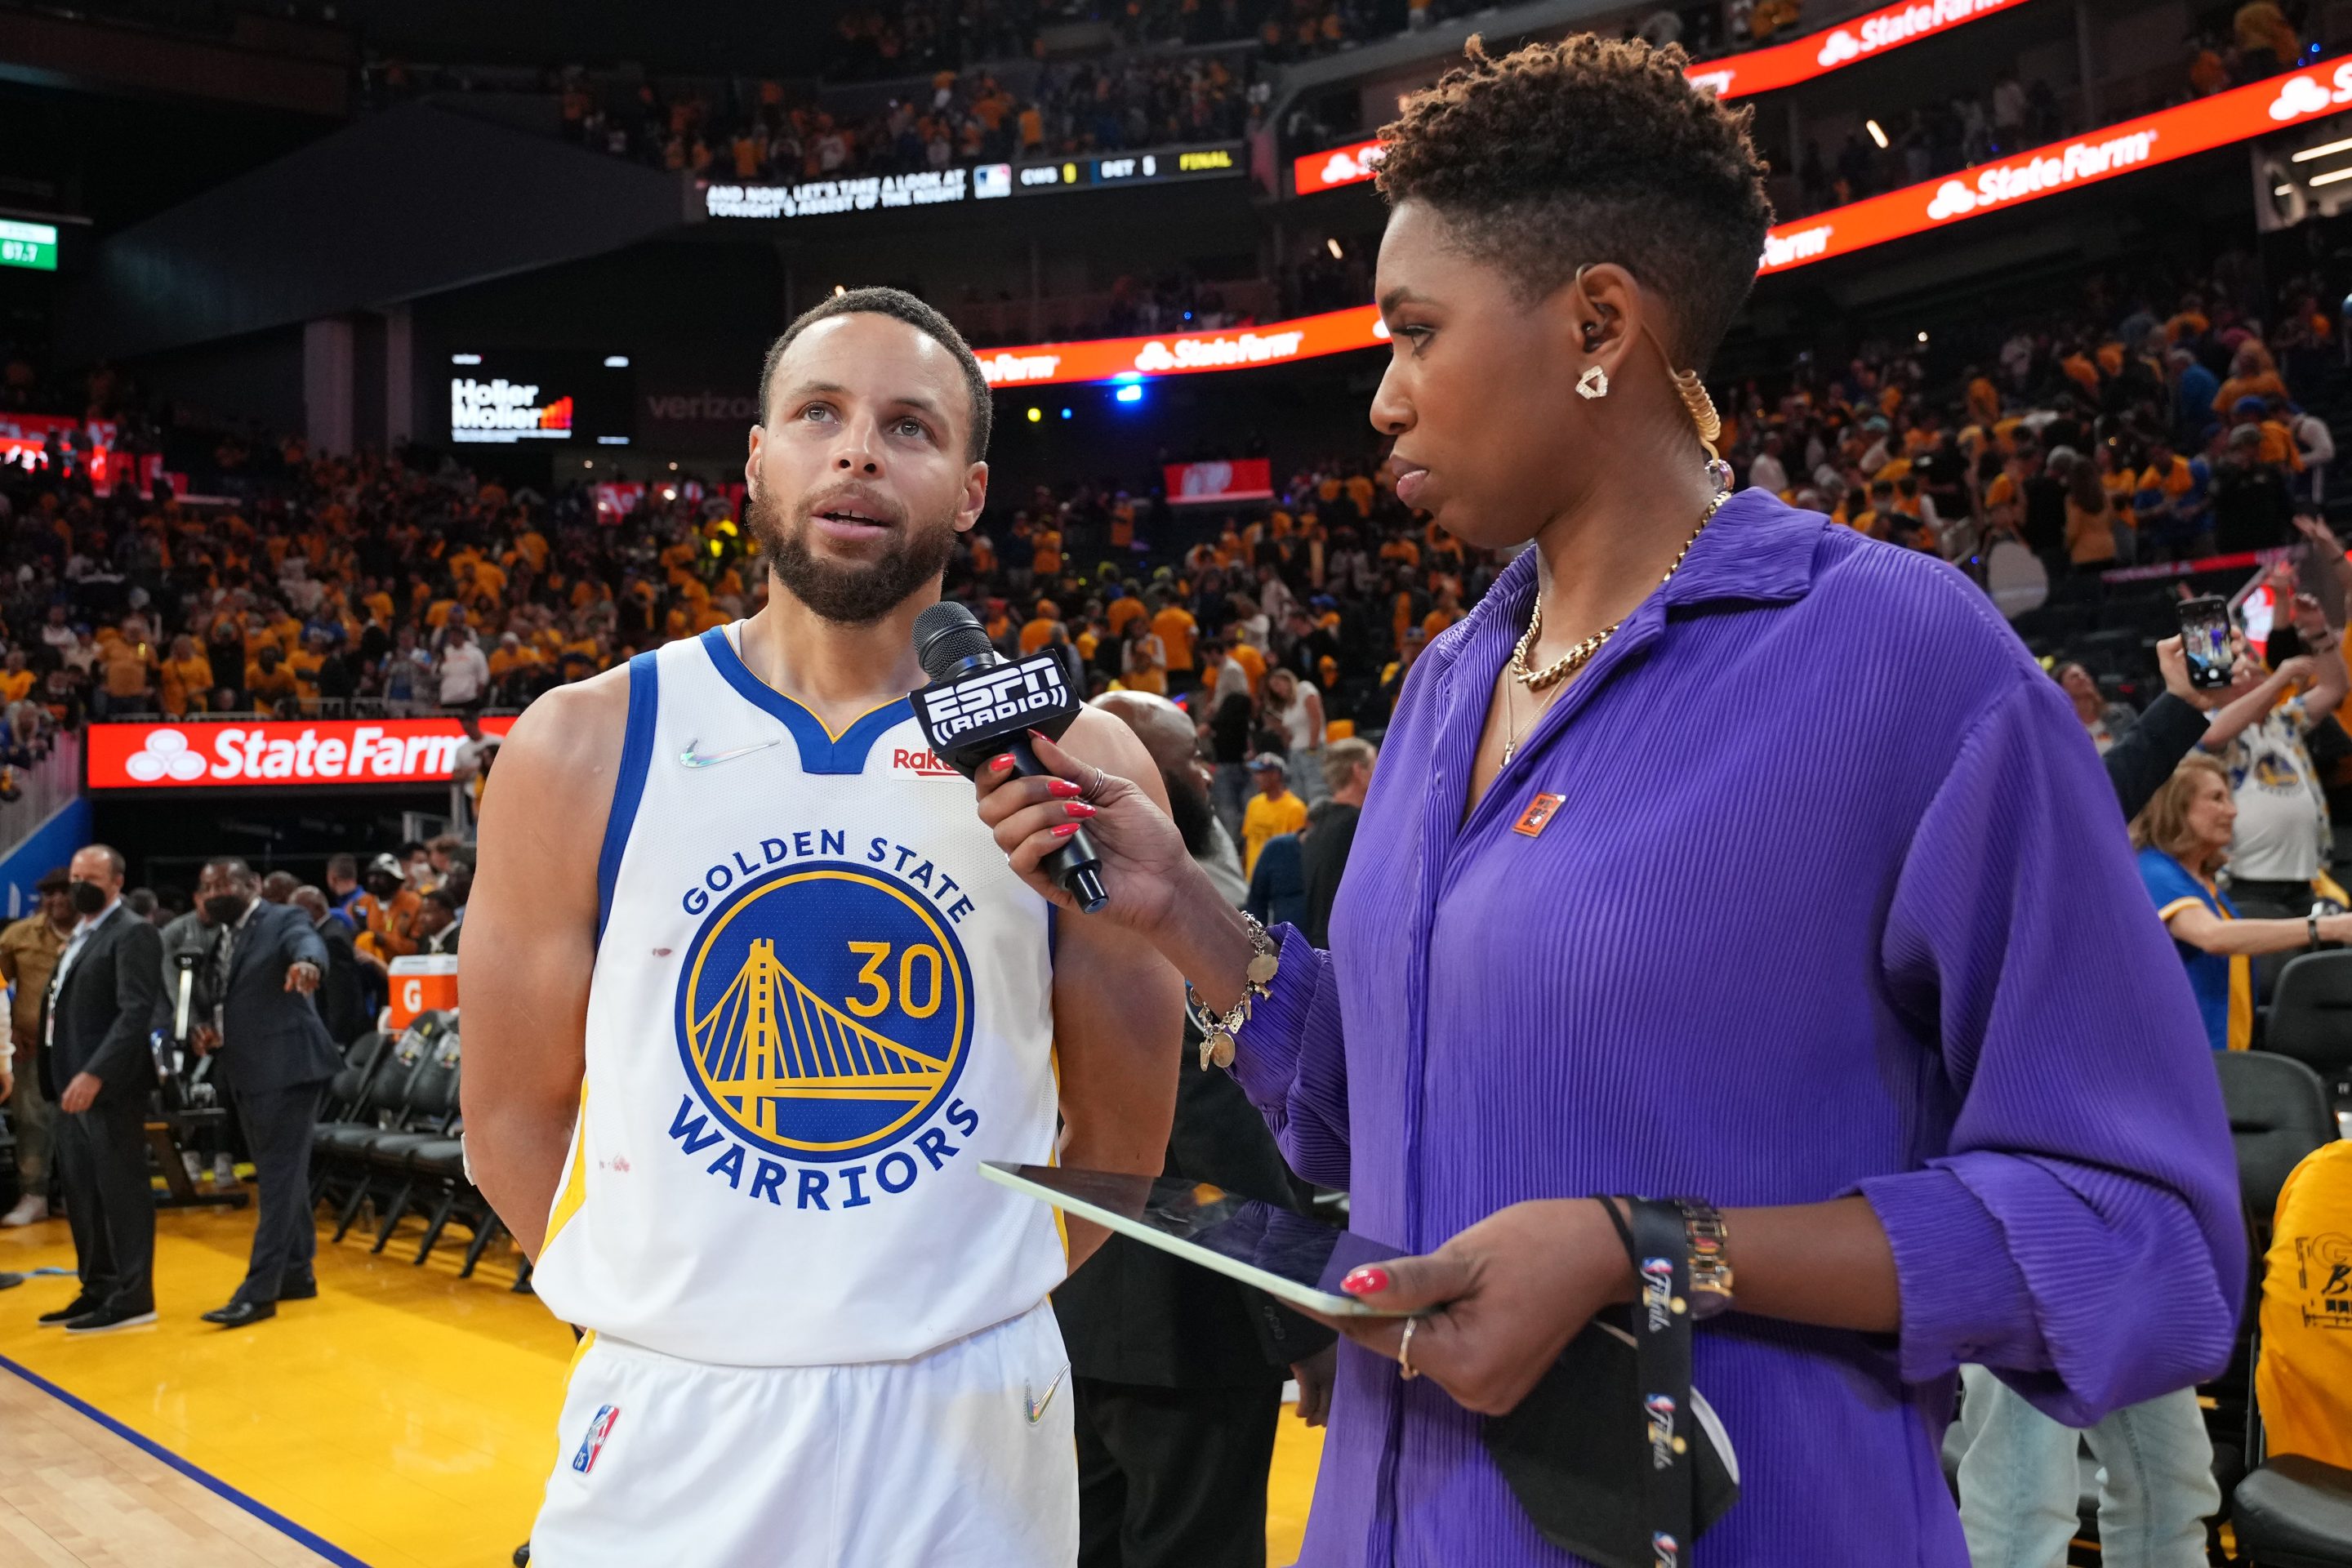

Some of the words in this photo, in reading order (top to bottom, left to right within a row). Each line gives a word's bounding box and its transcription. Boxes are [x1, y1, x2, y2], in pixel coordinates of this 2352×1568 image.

[706, 185, 745, 203] AND
[838, 176, 880, 196] TAKE
[881, 175, 896, 193] A
[896, 170, 941, 192] LOOK
[942, 167, 967, 186] AT
[1178, 149, 1233, 172] FINAL
[797, 194, 854, 217] ASSIST
[854, 193, 880, 211] OF
[880, 190, 912, 208] THE
[912, 185, 967, 205] NIGHT
[924, 657, 1061, 724] ESPN
[951, 691, 1050, 734] RADIO
[683, 829, 845, 915] GOLDEN
[867, 837, 976, 924] STATE
[403, 979, 422, 1014] G
[844, 941, 942, 1019] 30
[668, 1094, 979, 1211] WARRIORS
[1639, 1266, 1672, 1334] Finals
